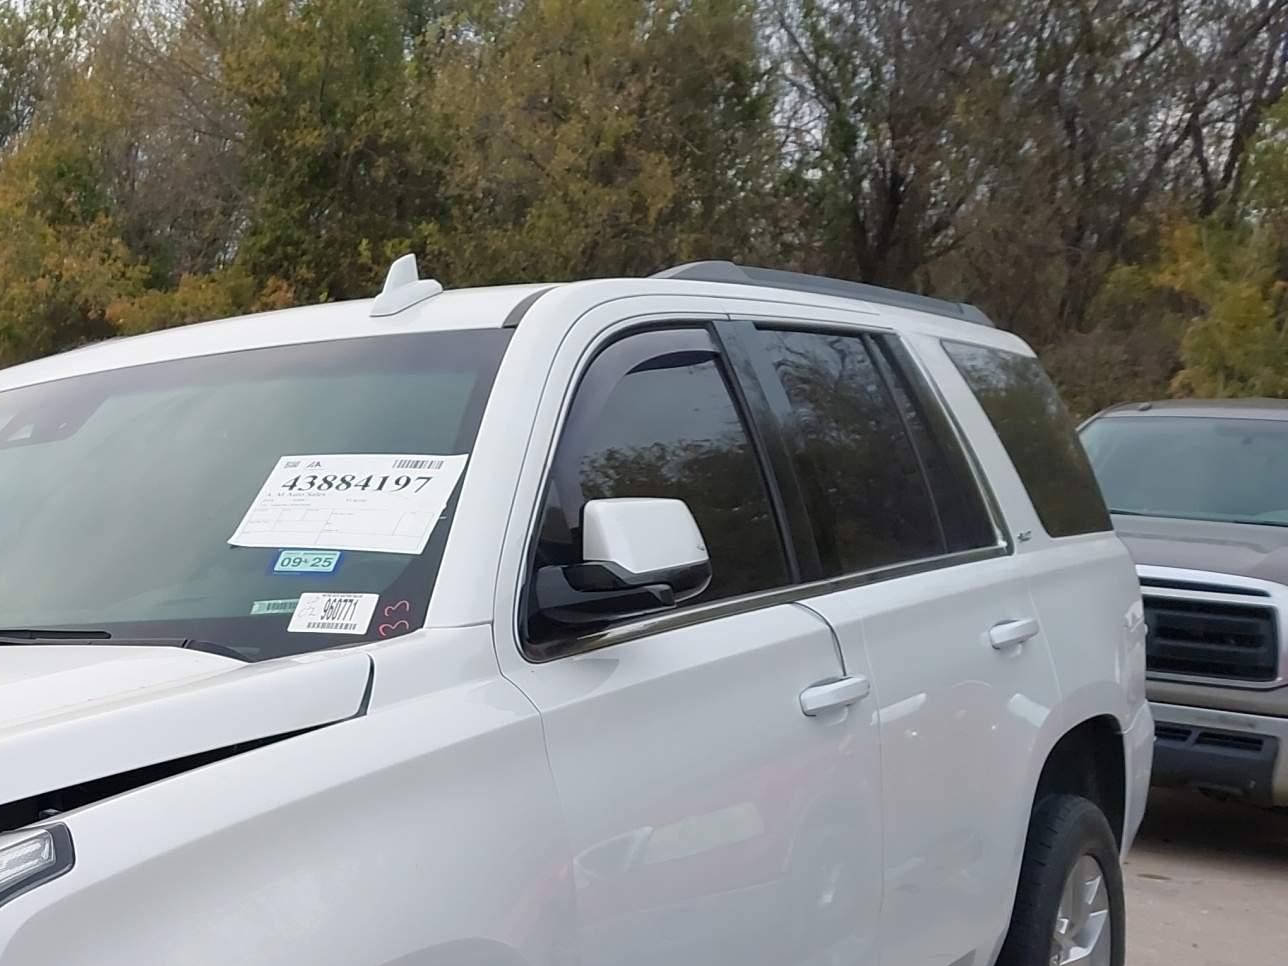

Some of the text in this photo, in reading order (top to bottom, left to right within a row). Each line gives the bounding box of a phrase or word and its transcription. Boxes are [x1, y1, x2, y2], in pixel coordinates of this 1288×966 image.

[282, 474, 432, 493] 43884197
[281, 557, 333, 568] 09 25
[320, 599, 358, 621] 960771
